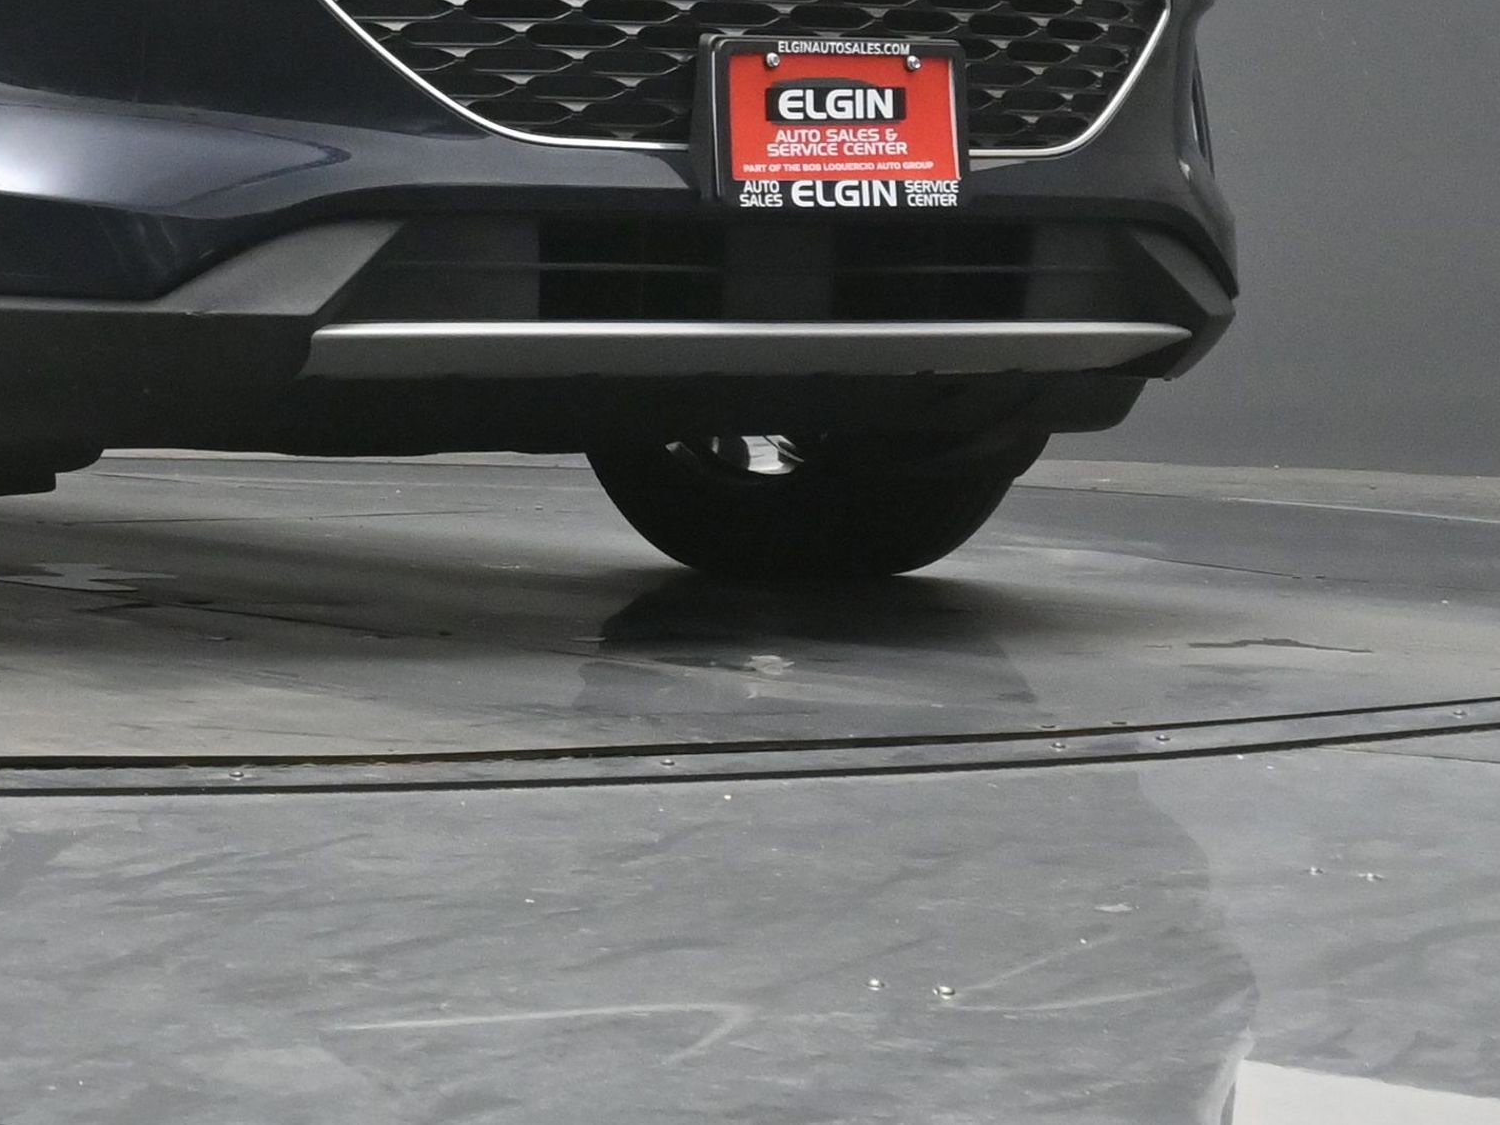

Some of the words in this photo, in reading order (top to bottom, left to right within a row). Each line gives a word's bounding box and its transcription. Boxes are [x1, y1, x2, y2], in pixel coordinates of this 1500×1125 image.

[777, 40, 911, 55] ELGINAUTOSALES.COM
[778, 88, 894, 120] ELGIN
[775, 129, 821, 143] AUTO
[825, 129, 880, 142] SALES
[885, 128, 898, 142] &
[766, 143, 839, 157] SERVICE
[843, 141, 909, 156] CENTER
[743, 163, 767, 173] PART
[768, 163, 782, 172] OF
[783, 163, 801, 173] THE
[876, 161, 901, 171] AUTO
[902, 161, 935, 171] GROUP
[743, 180, 780, 194] AUTO
[791, 179, 898, 207] ELGIN
[904, 179, 960, 194] SERVICE
[739, 193, 784, 208] SALES
[906, 193, 958, 207] CENTER
